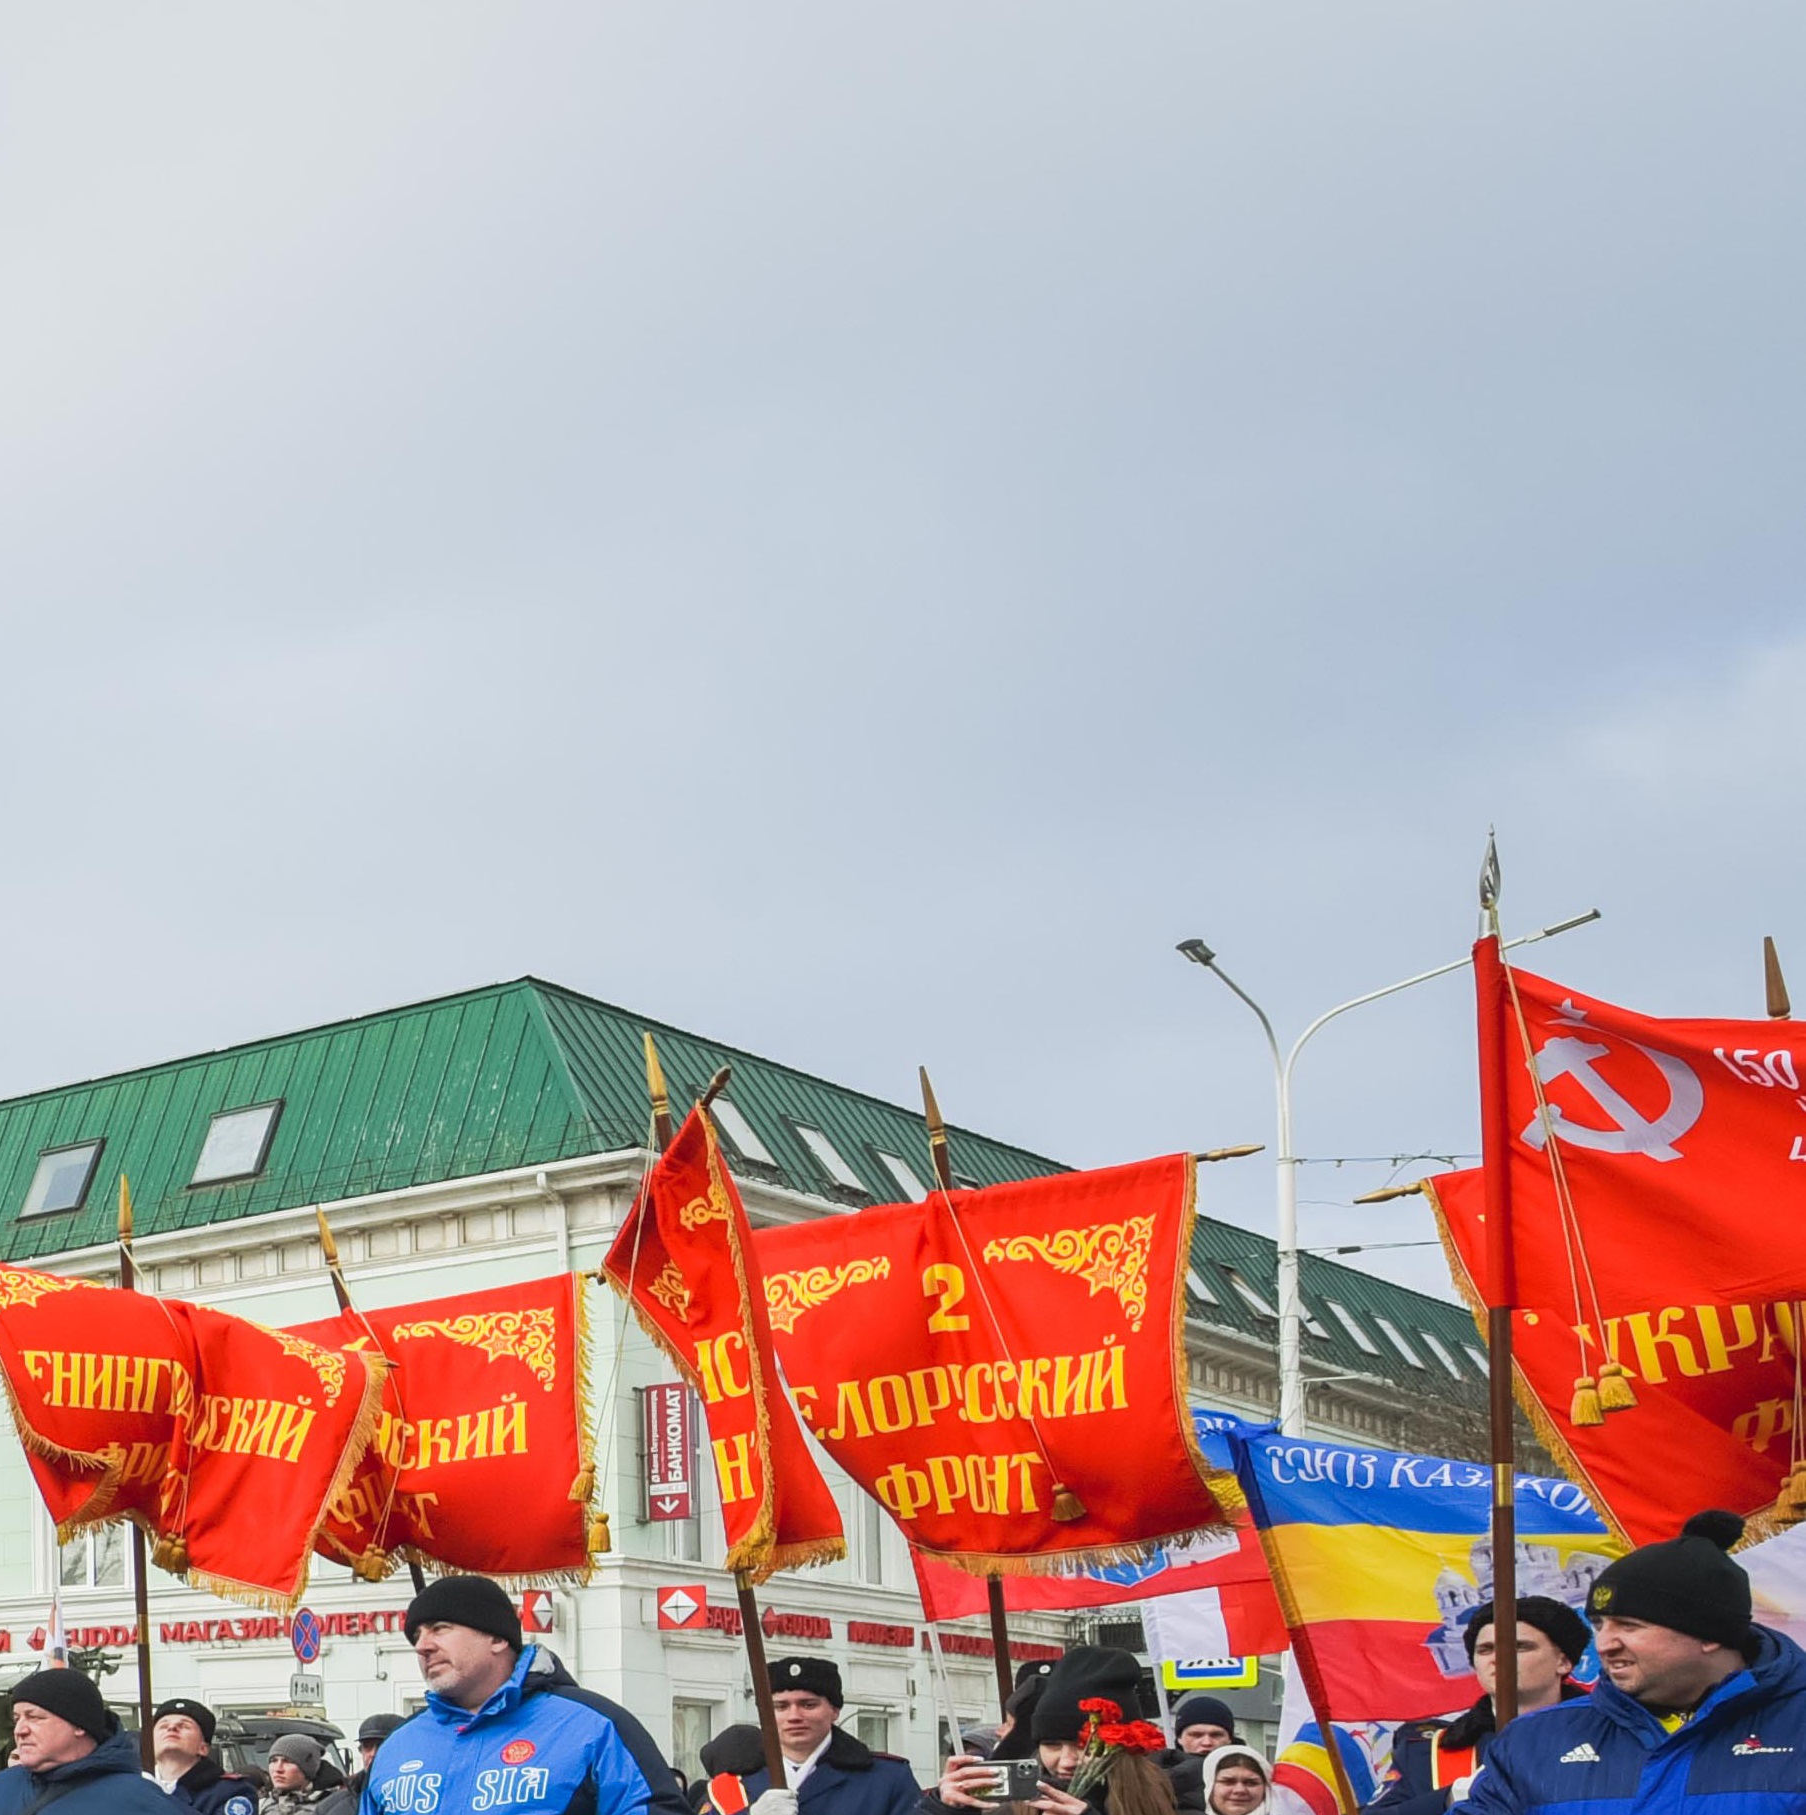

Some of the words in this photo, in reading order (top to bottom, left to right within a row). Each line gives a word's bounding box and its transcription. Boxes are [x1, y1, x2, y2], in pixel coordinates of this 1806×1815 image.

[1714, 1048, 1799, 1090] 150
[921, 1263, 970, 1334] 2
[666, 1387, 683, 1481] БАНКОМАТ
[1389, 1457, 1593, 1522] КАЗКО
[160, 1615, 291, 1644] МАГАЗИН
